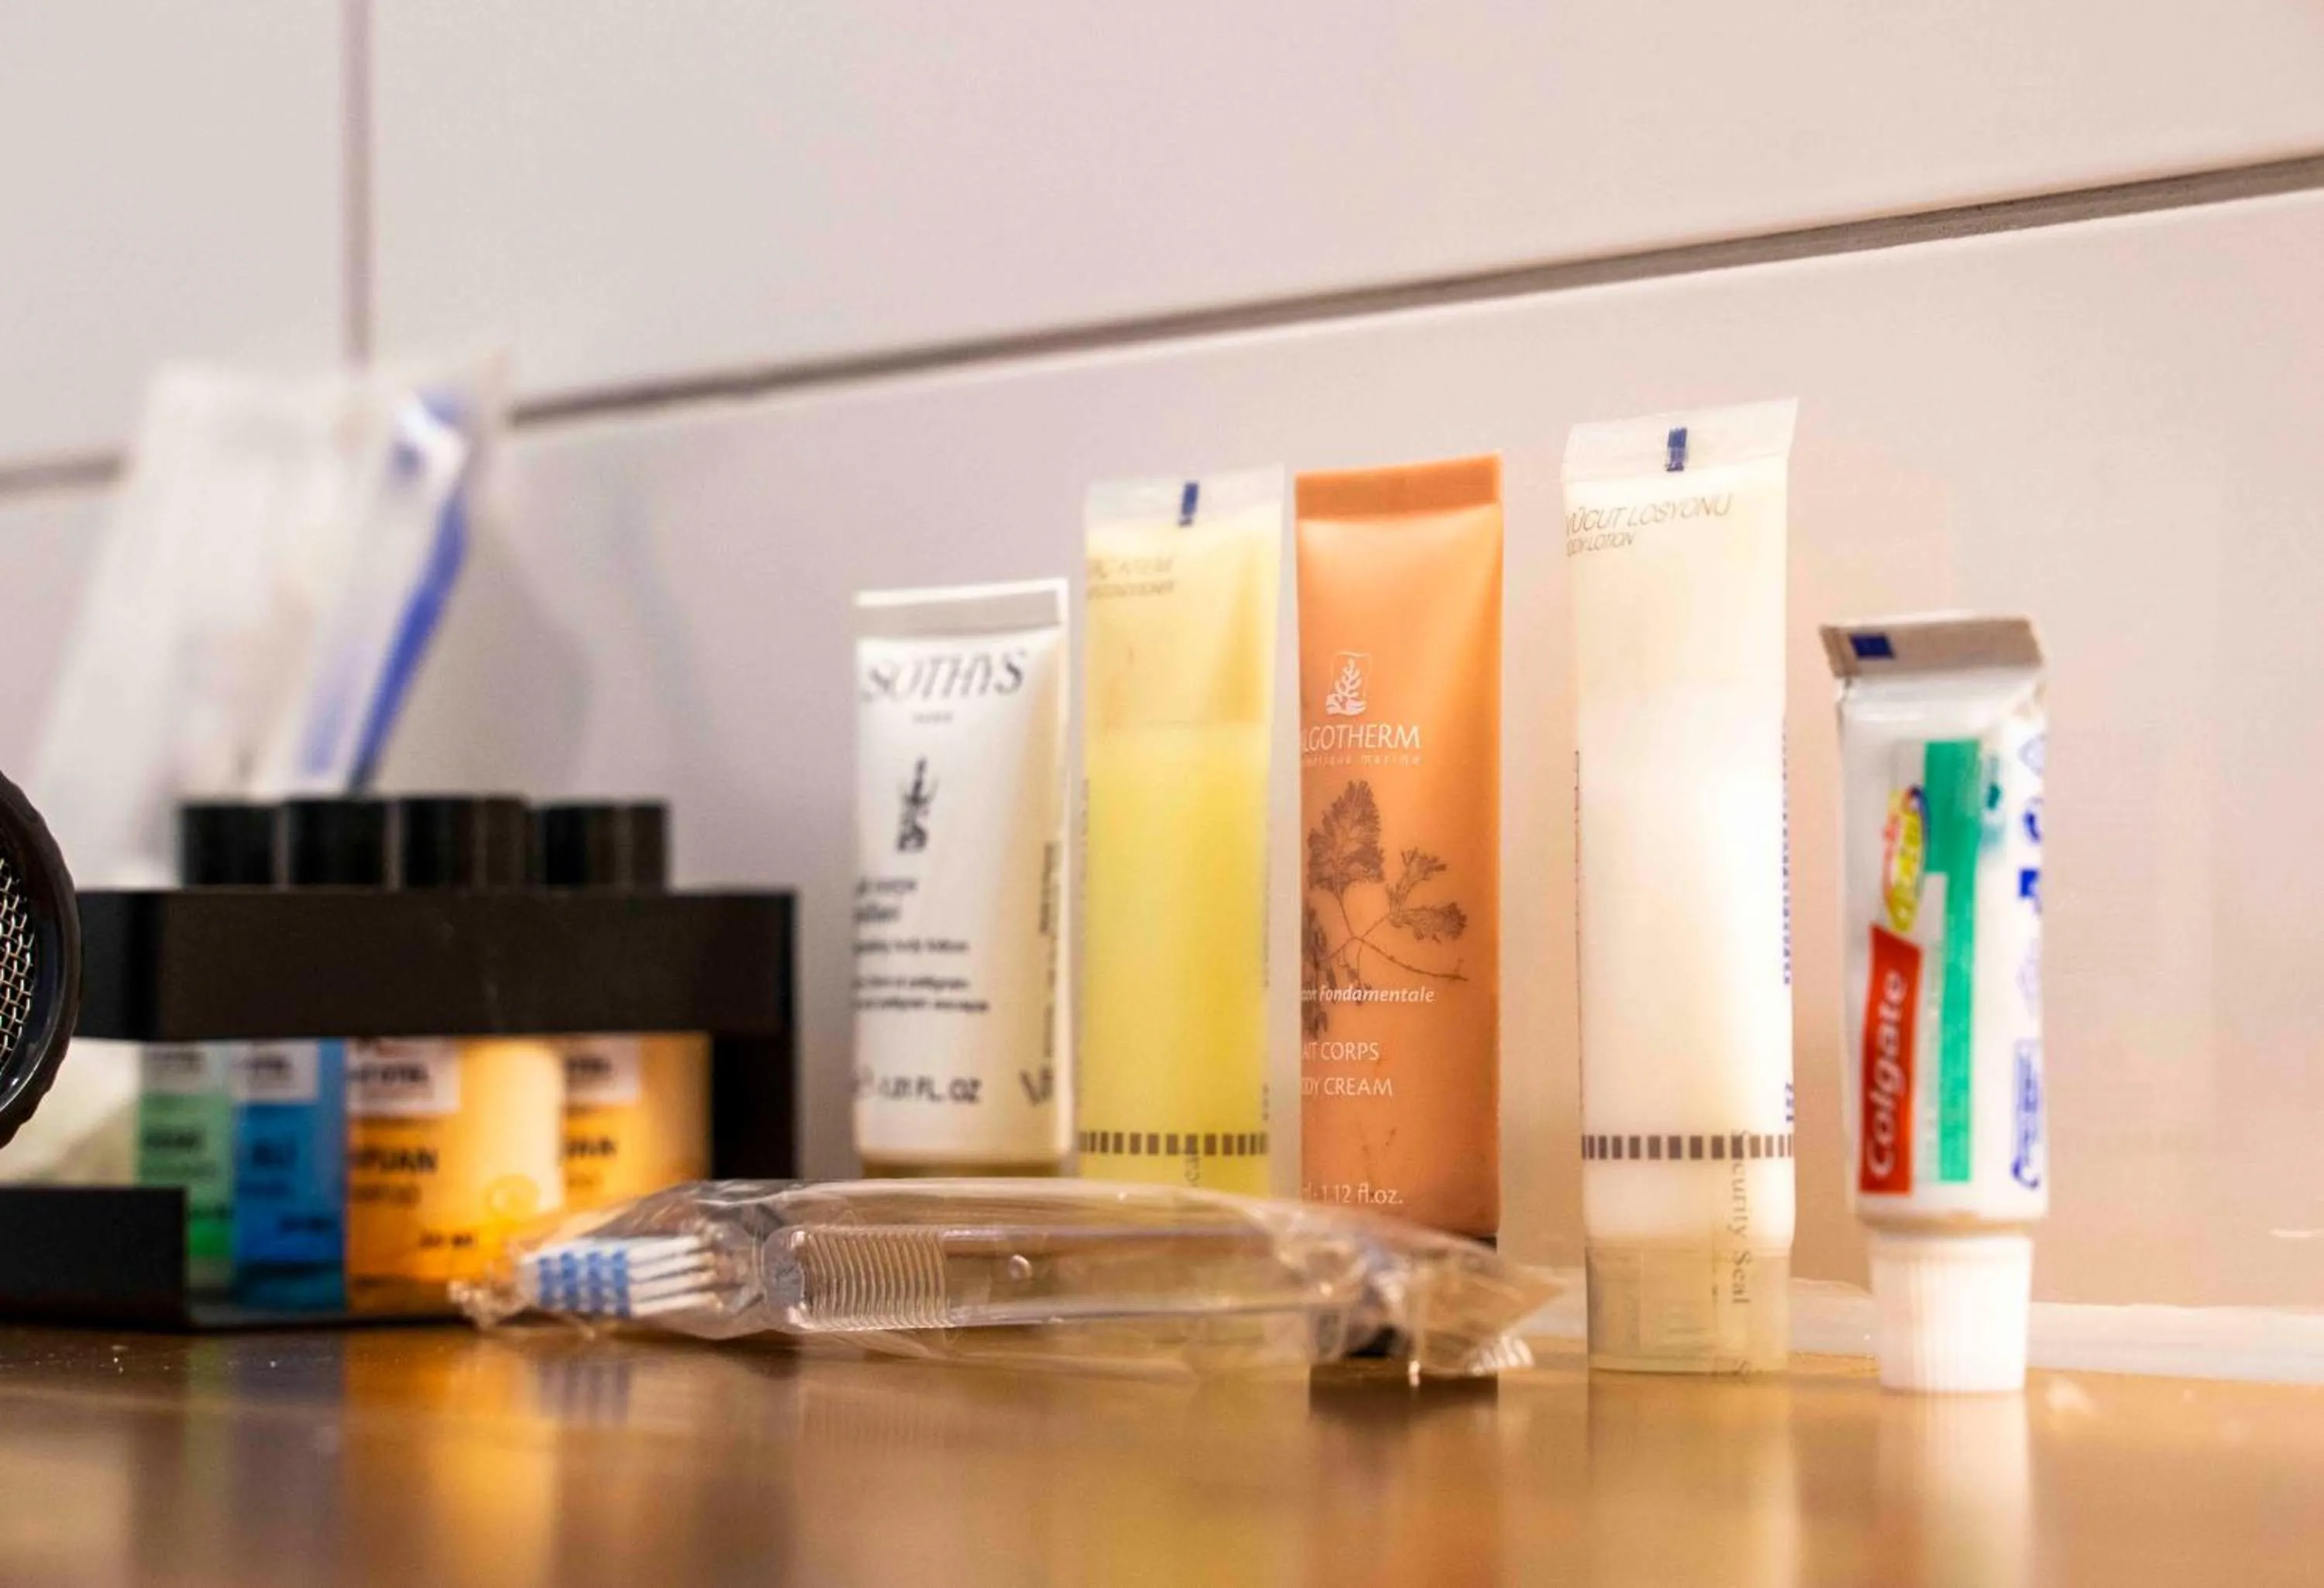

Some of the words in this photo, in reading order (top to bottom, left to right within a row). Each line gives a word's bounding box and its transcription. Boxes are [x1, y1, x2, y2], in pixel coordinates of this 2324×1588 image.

[1627, 493, 1733, 527] LOSYONU
[861, 653, 1024, 701] SOTHYS
[1302, 724, 1422, 752] LGOTHERM
[1320, 1041, 1380, 1061] CORPS
[1324, 1077, 1394, 1098] CREAM
[1866, 970, 1908, 1180] Colgate
